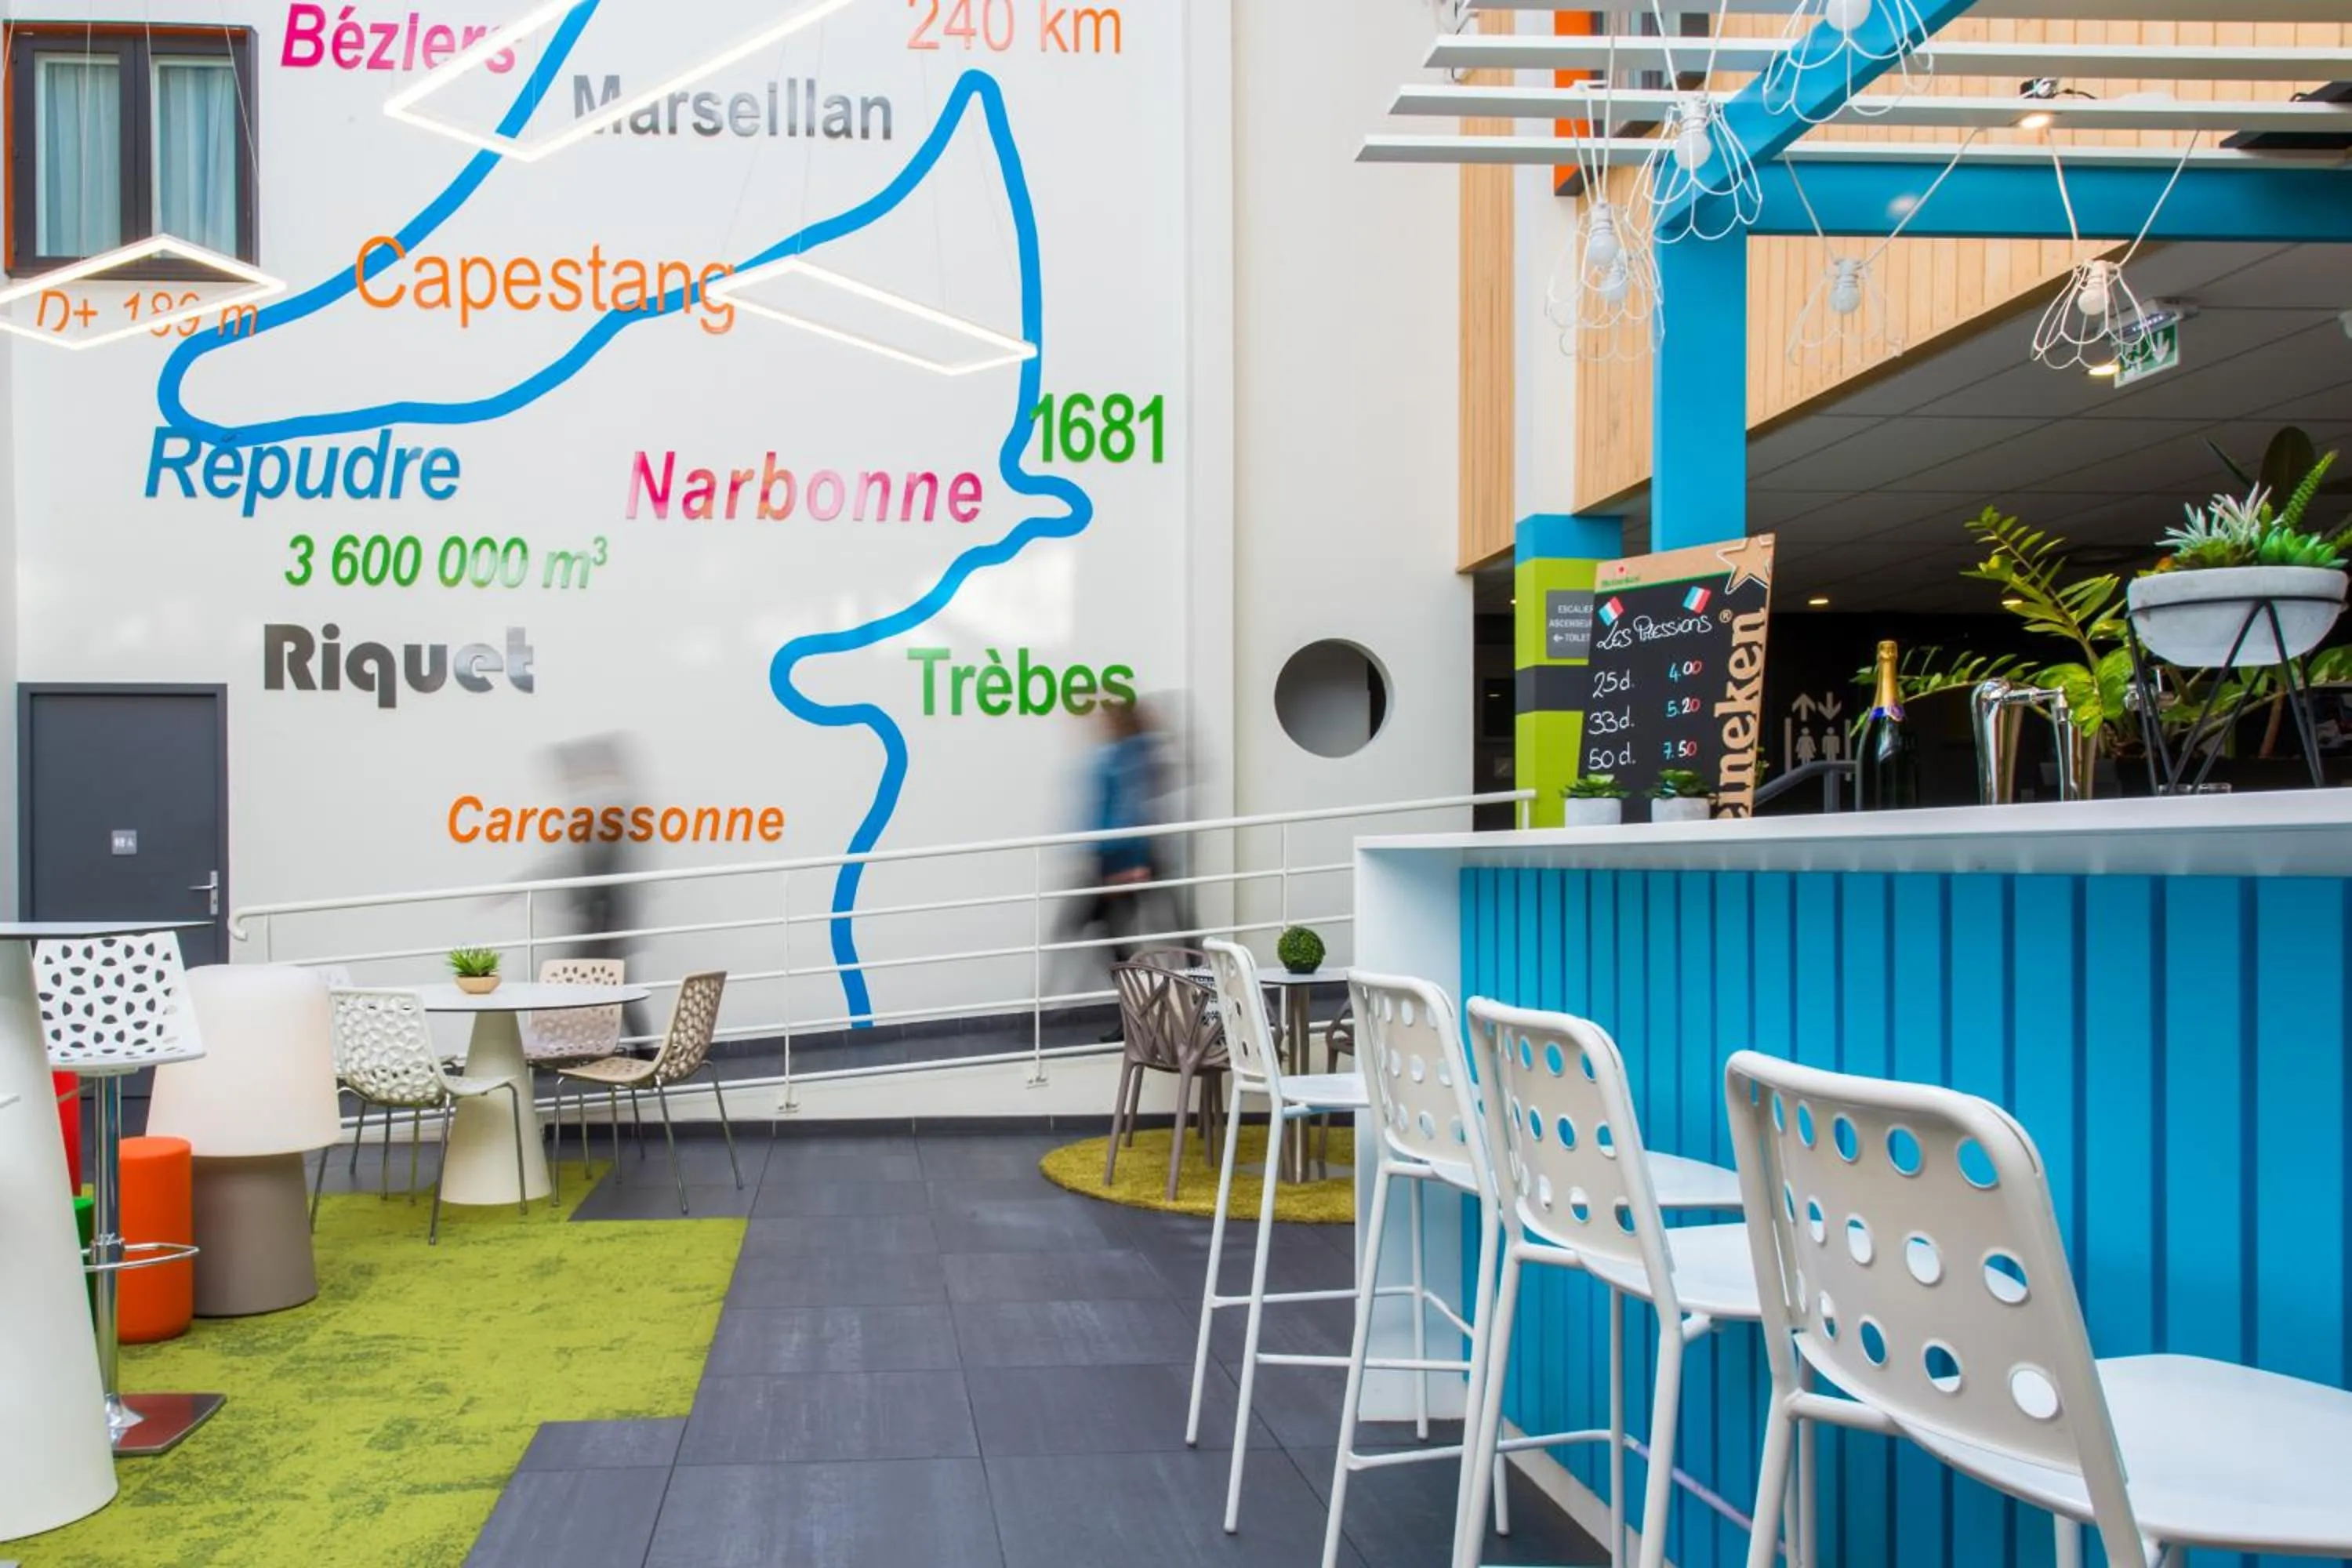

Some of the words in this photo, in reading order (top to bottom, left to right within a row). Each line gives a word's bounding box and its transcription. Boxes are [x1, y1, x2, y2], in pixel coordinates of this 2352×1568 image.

[906, 0, 1014, 53] 240
[1040, 0, 1122, 54] km
[573, 74, 893, 141] Marseillan
[36, 288, 99, 333] D+
[218, 302, 259, 338] m
[355, 234, 735, 335] Capestang
[1030, 390, 1166, 465] 1681
[144, 427, 461, 517] Répudre
[626, 450, 984, 524] Narbonne
[284, 533, 316, 588] 3
[330, 533, 423, 588] 600
[437, 534, 529, 589] 000
[1548, 618, 1593, 629] ASCENSEU
[1565, 632, 1592, 643] TOILET
[263, 622, 535, 710] Riquet
[906, 646, 1138, 717] Trèbes
[1714, 607, 1766, 819] ineken
[448, 795, 786, 844] Carcassonne
